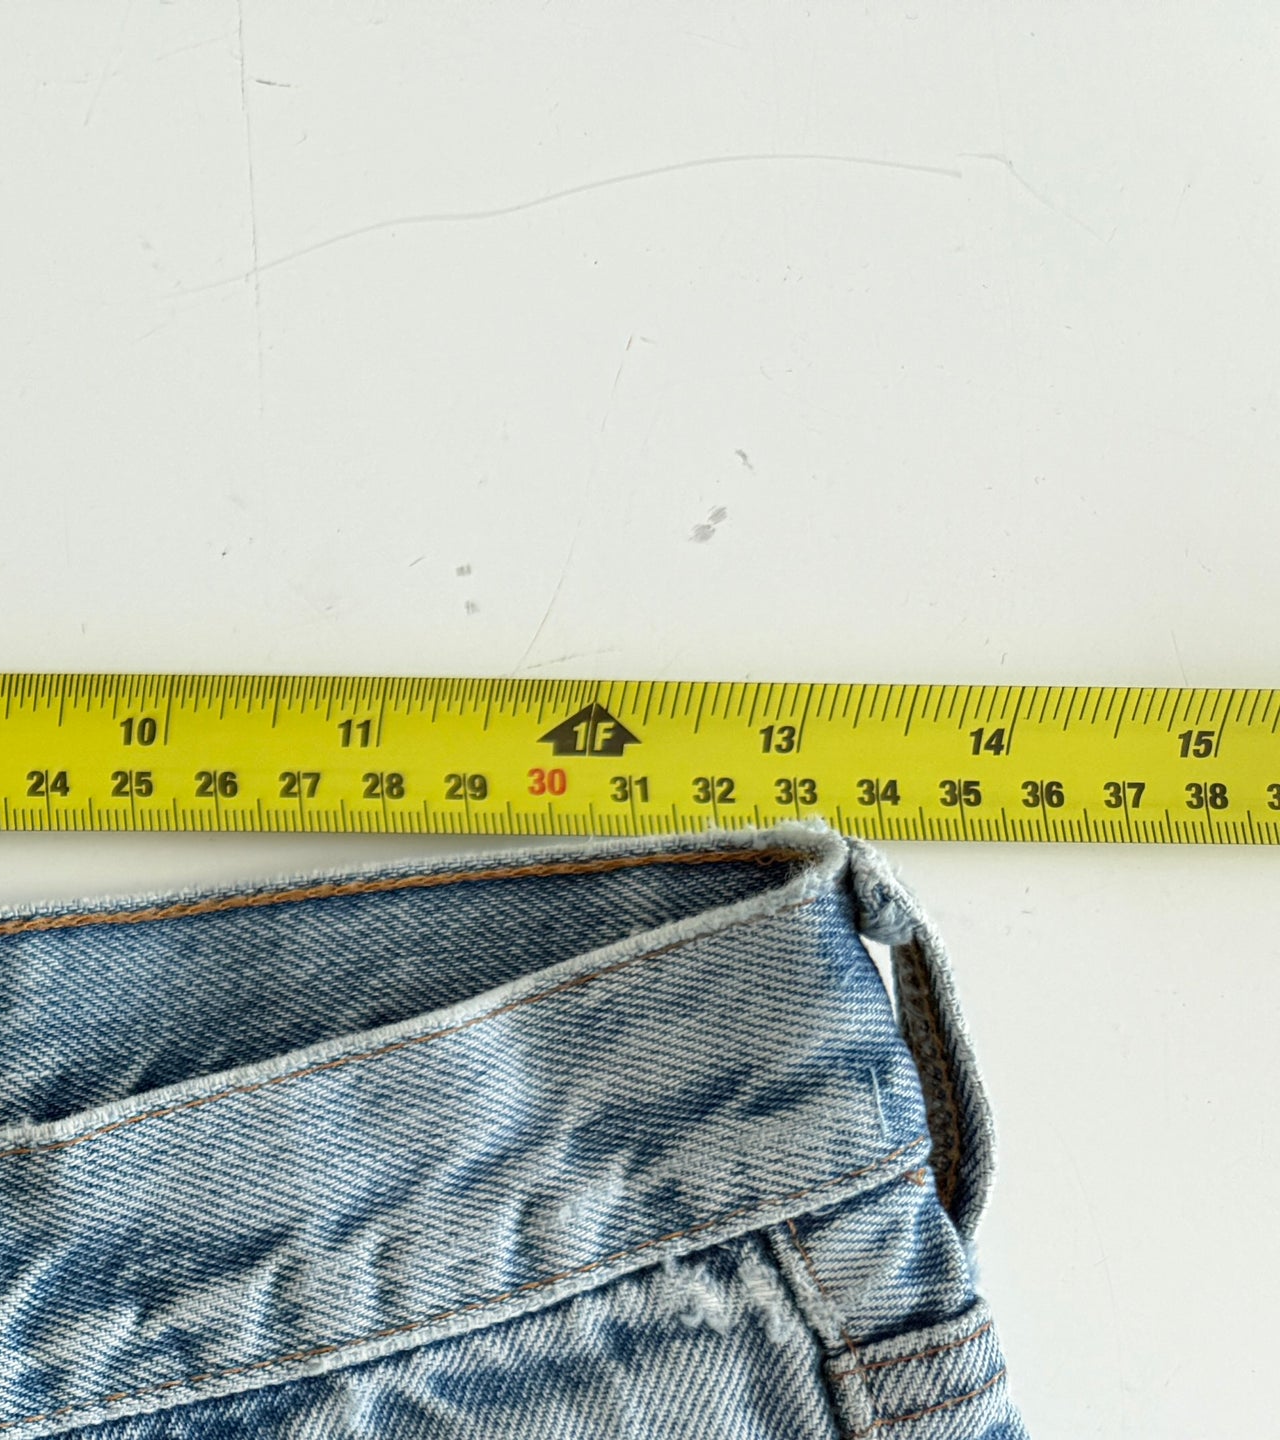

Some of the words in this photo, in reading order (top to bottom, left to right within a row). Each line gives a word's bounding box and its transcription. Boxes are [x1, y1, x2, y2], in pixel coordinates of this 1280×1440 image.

[120, 717, 157, 746] 10
[338, 719, 371, 748] 11
[573, 721, 615, 751] 1F
[759, 725, 796, 754] 13
[969, 727, 1005, 756] 14
[1178, 730, 1215, 758] 15
[26, 770, 69, 797] 24
[111, 770, 153, 798] 25
[194, 770, 238, 798] 26
[279, 771, 321, 798] 27
[362, 772, 404, 800] 28
[444, 773, 487, 801] 29
[527, 768, 567, 795] 30
[609, 776, 649, 803] 31
[692, 776, 735, 804] 32
[774, 778, 818, 805] 33
[856, 779, 900, 806] 34
[939, 780, 982, 808] 35
[1021, 781, 1065, 808] 36
[1103, 782, 1146, 809] 37
[1185, 783, 1229, 810] 38
